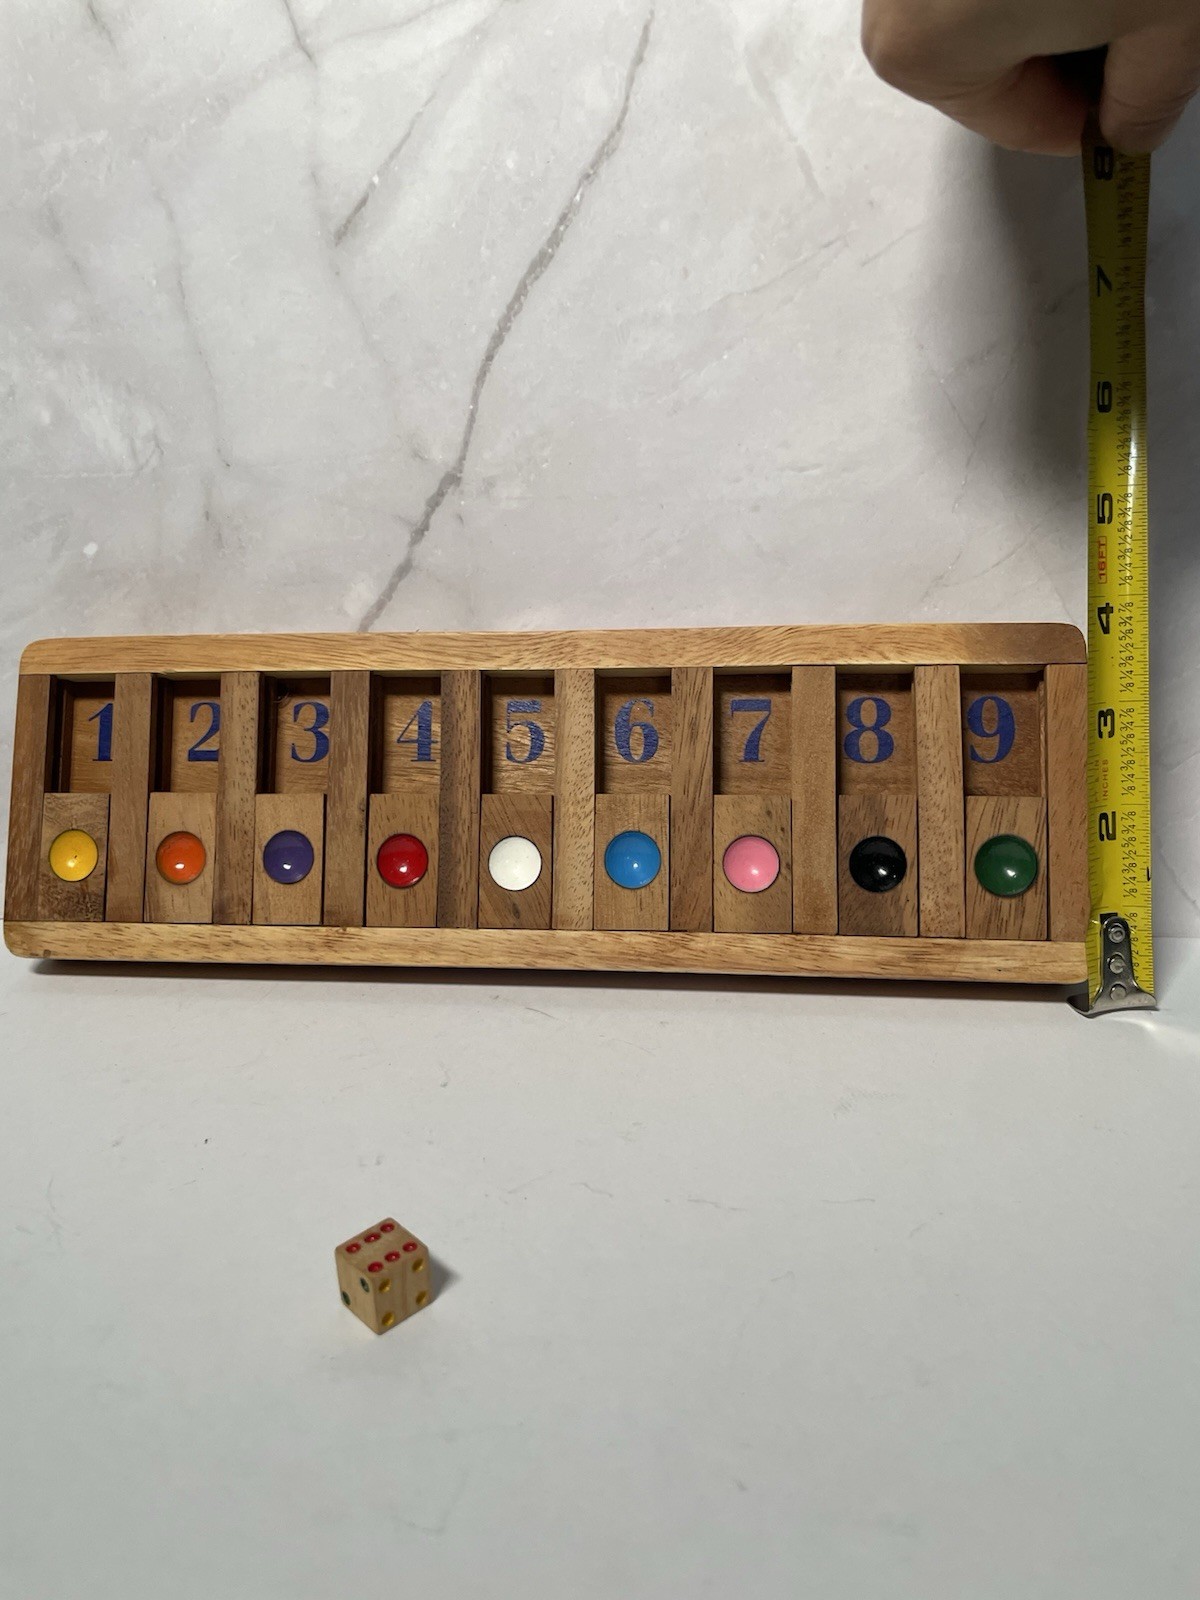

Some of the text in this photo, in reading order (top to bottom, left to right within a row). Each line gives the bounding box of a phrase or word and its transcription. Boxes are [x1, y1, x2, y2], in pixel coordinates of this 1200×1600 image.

[1093, 146, 1113, 180] 8
[1096, 265, 1112, 297] 7
[1097, 381, 1112, 413] 6
[1097, 493, 1113, 525] 5
[1097, 602, 1113, 634] 4
[88, 696, 1016, 764] 1 2 3 4 5 6 7 8 9
[1098, 708, 1114, 739] 3
[1098, 811, 1116, 841] 2
